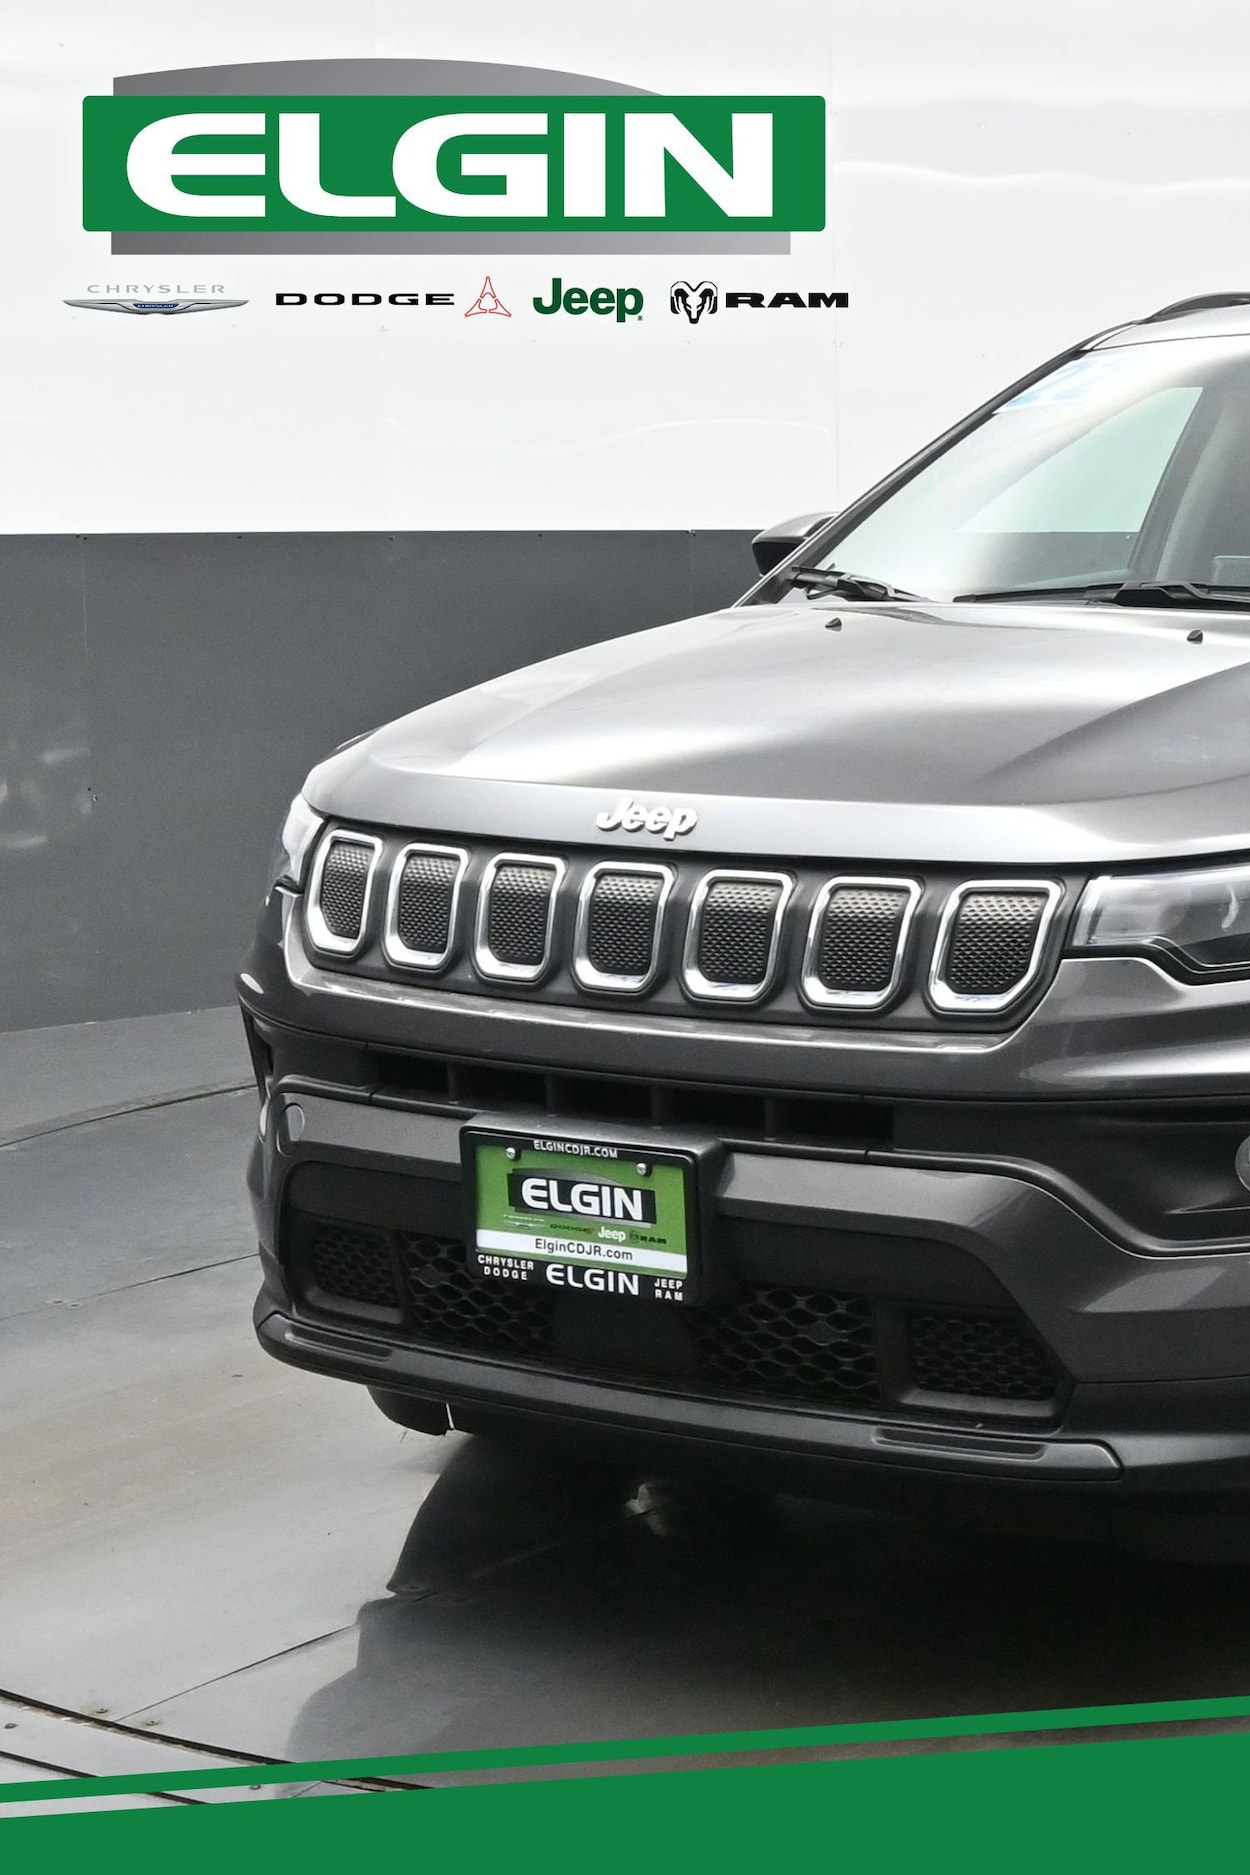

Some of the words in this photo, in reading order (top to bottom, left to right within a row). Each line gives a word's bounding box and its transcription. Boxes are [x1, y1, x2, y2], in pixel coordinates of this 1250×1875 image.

[596, 797, 698, 841] Jeep
[533, 1140, 618, 1159] ELGINCDJR.COM
[521, 1177, 643, 1221] ELGIN
[598, 1226, 627, 1243] Jeep
[535, 1238, 633, 1261] ElginCDJR.com
[477, 1254, 534, 1271] CHRYSLER
[484, 1265, 528, 1281] DODGE
[545, 1263, 640, 1296] ELGIN
[654, 1278, 683, 1290] JEEP
[655, 1289, 683, 1301] RAM
